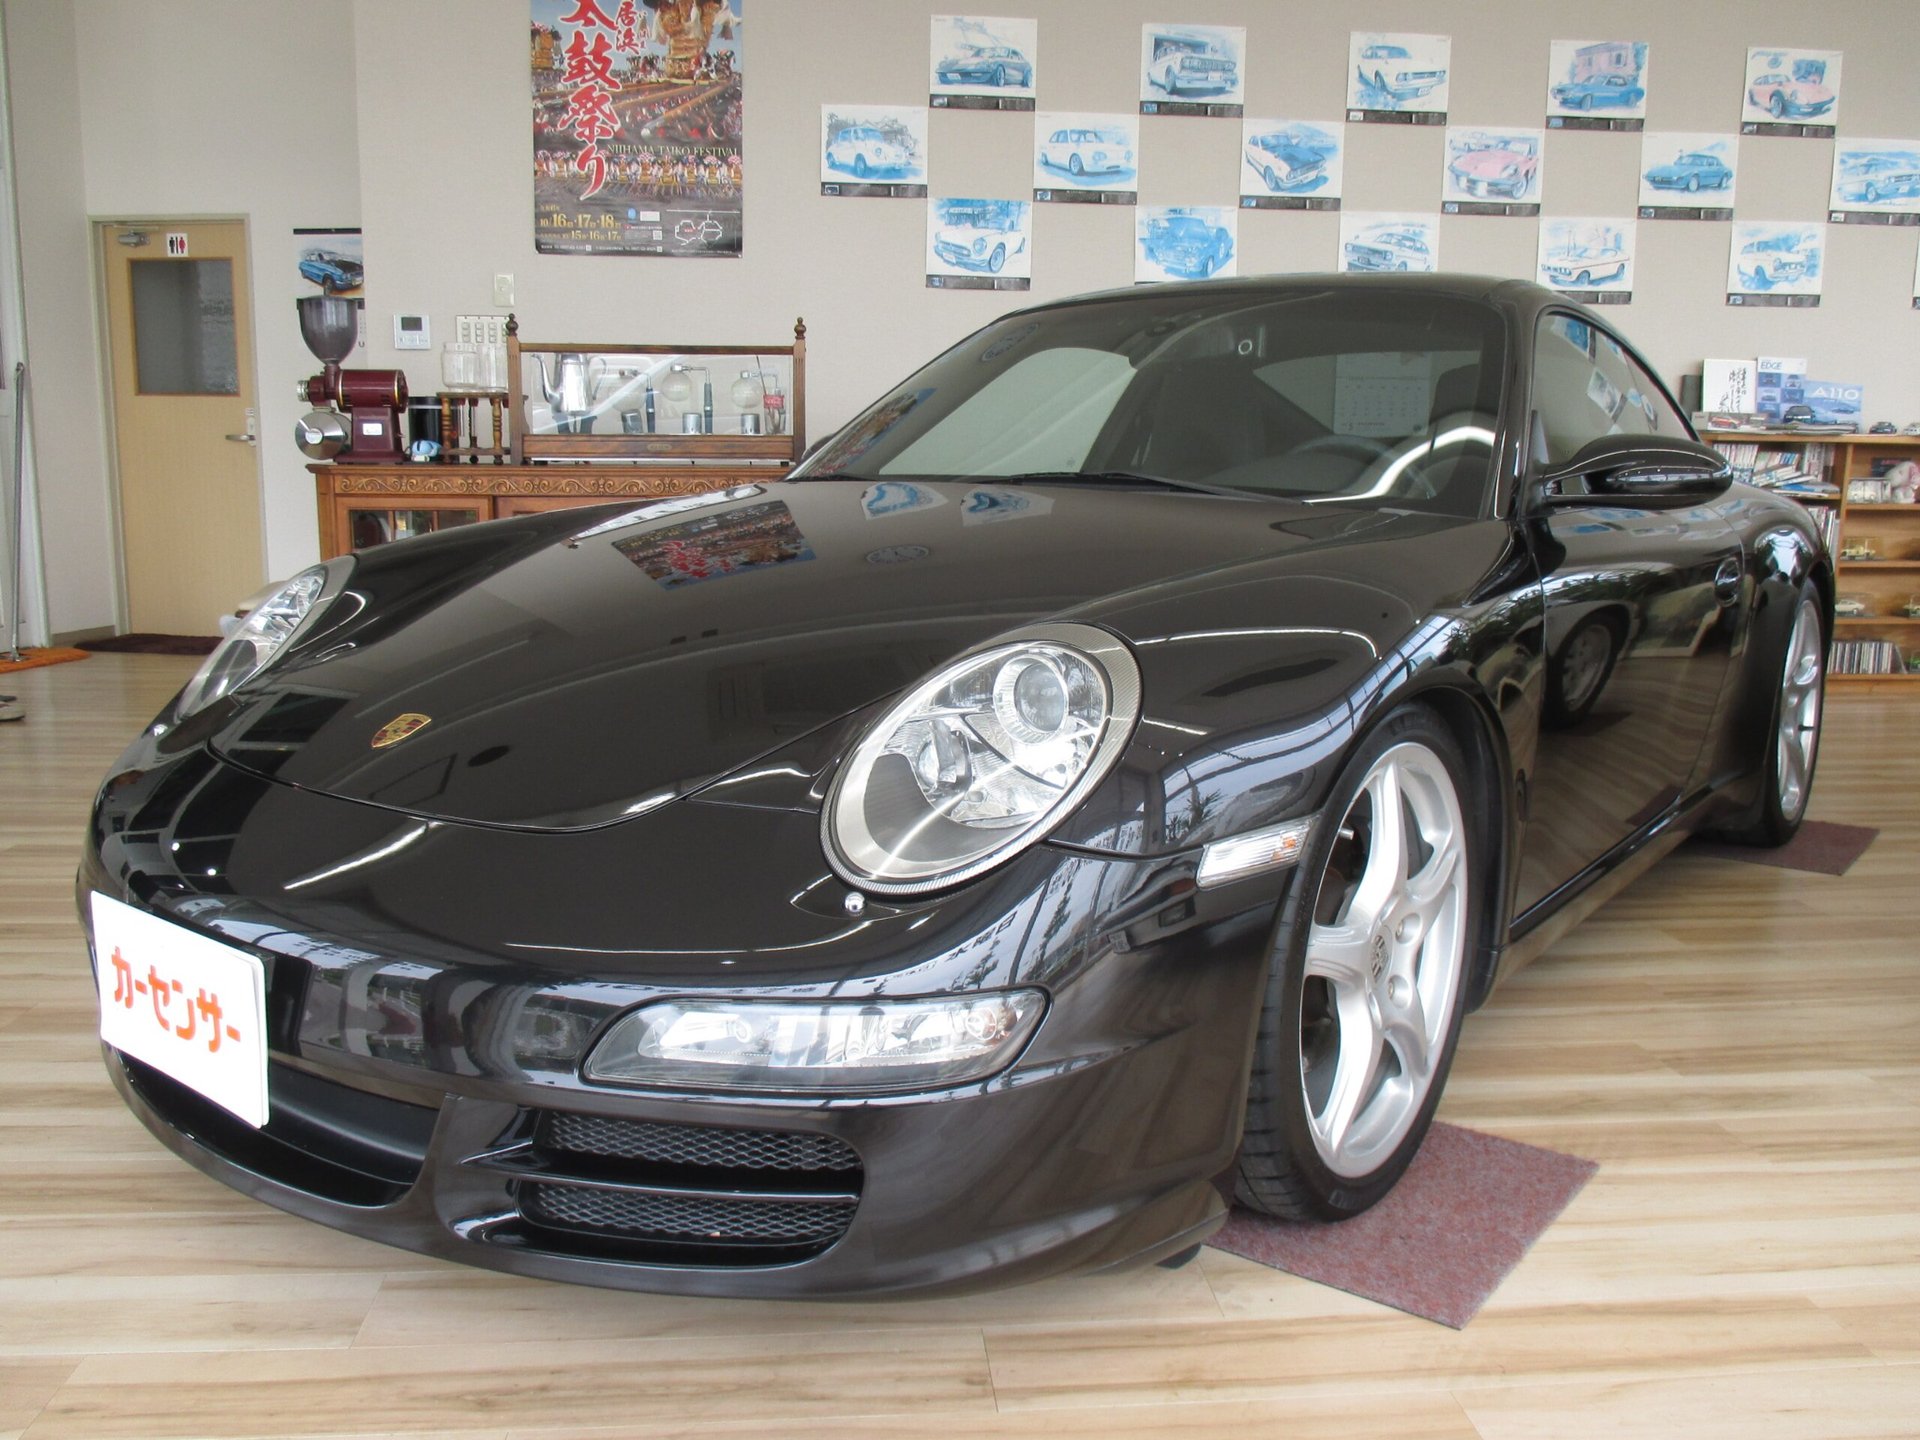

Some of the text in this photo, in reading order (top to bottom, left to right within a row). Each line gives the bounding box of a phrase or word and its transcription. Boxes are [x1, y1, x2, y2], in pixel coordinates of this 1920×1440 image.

[607, 144, 738, 156] NIIHAMA TAIKO FESTIVAL
[1760, 361, 1782, 370] EDGE
[1813, 387, 1859, 401] A110
[111, 946, 241, 1053] カーセンサー
